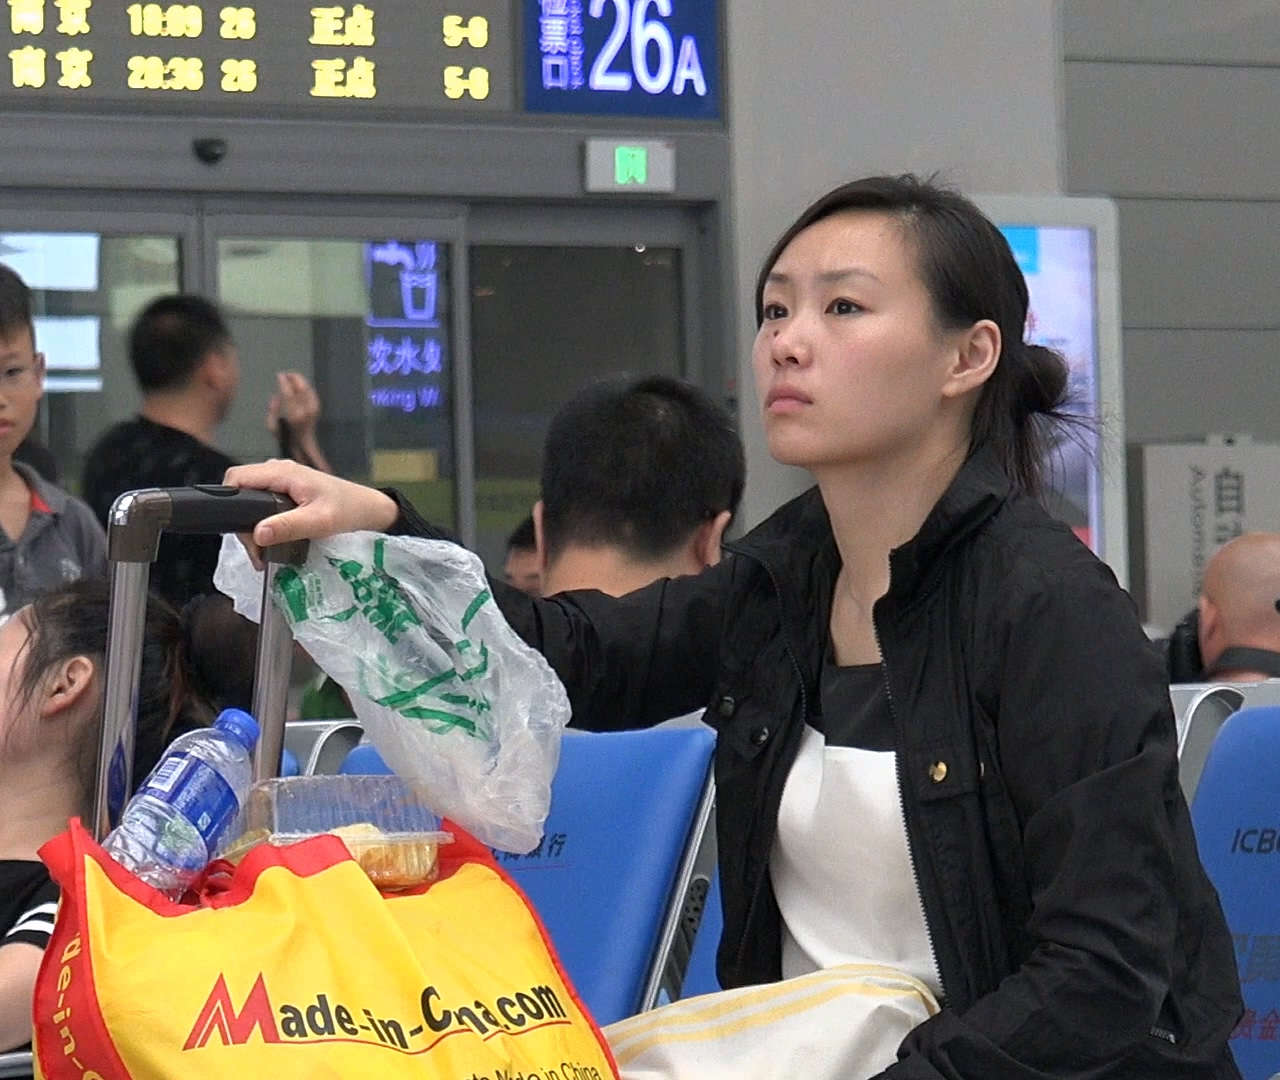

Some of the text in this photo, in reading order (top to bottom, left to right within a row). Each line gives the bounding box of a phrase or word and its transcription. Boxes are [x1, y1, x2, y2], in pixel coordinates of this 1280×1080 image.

[7, 0, 92, 35] 南京
[220, 7, 256, 39] 26
[309, 4, 375, 46] 正点
[589, 0, 707, 96] 26A
[8, 45, 93, 89] 南京
[221, 59, 257, 91] 26
[310, 56, 376, 98] 正点
[182, 972, 568, 1052] Made-in-Cna.com
